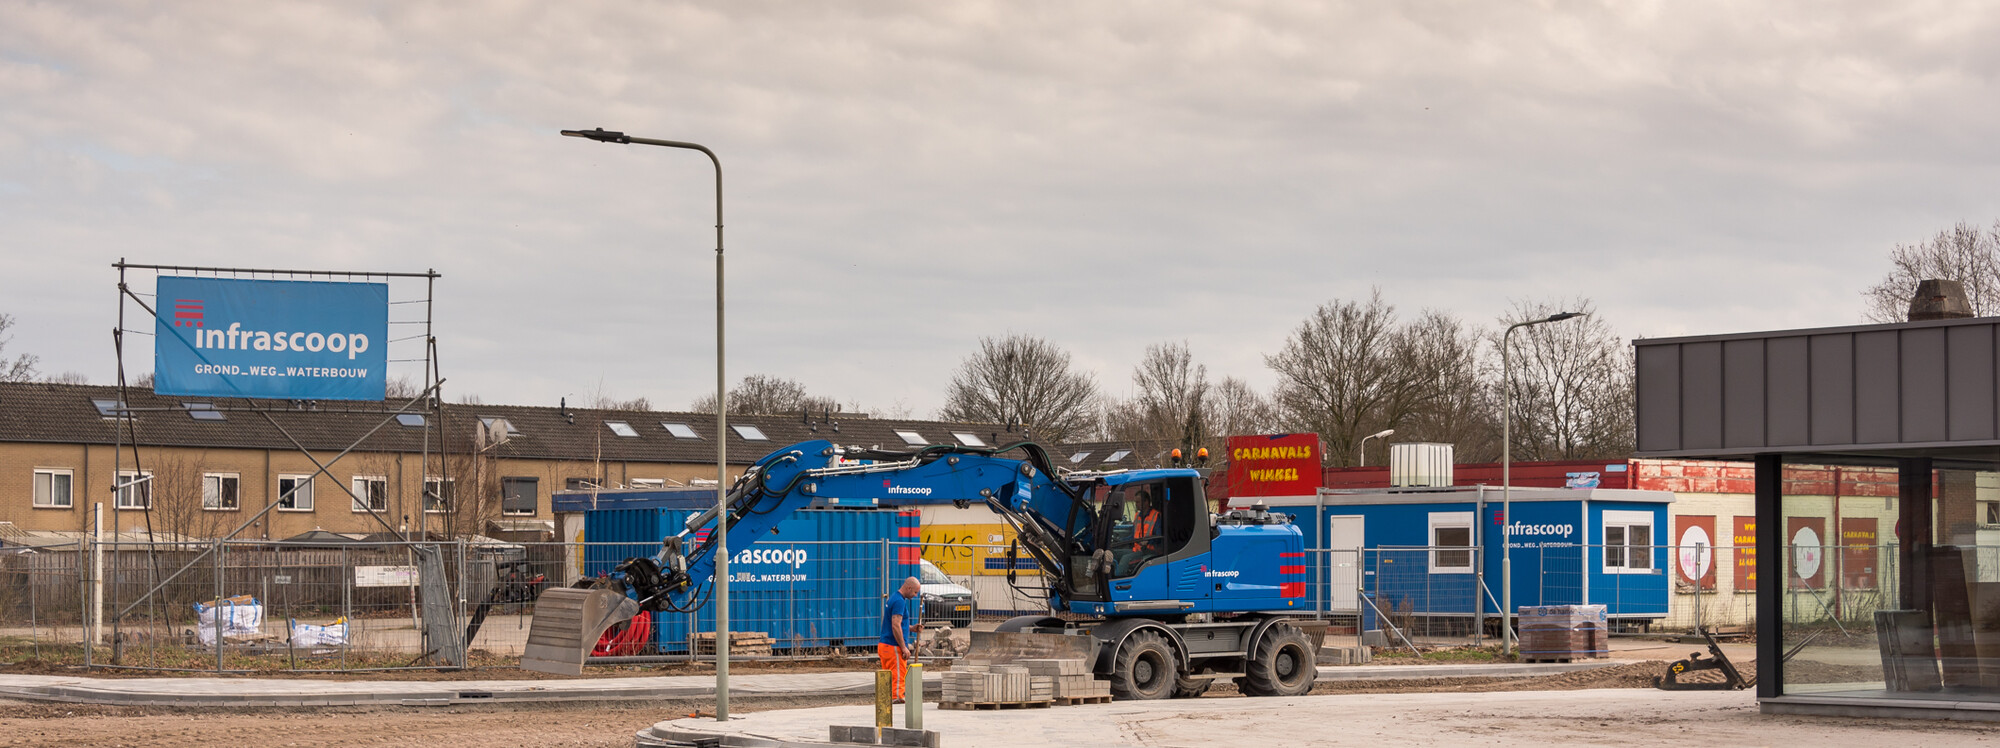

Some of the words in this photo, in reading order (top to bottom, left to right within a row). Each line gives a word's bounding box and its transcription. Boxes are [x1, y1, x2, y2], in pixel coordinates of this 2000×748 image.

[196, 322, 369, 360] infrascoop
[1233, 445, 1312, 461] CARNAVALS
[1249, 467, 1299, 482] WINKEL
[888, 485, 932, 496] infrascoop
[1734, 535, 1756, 544] CARNA
[1204, 569, 1239, 578] infrascoop
